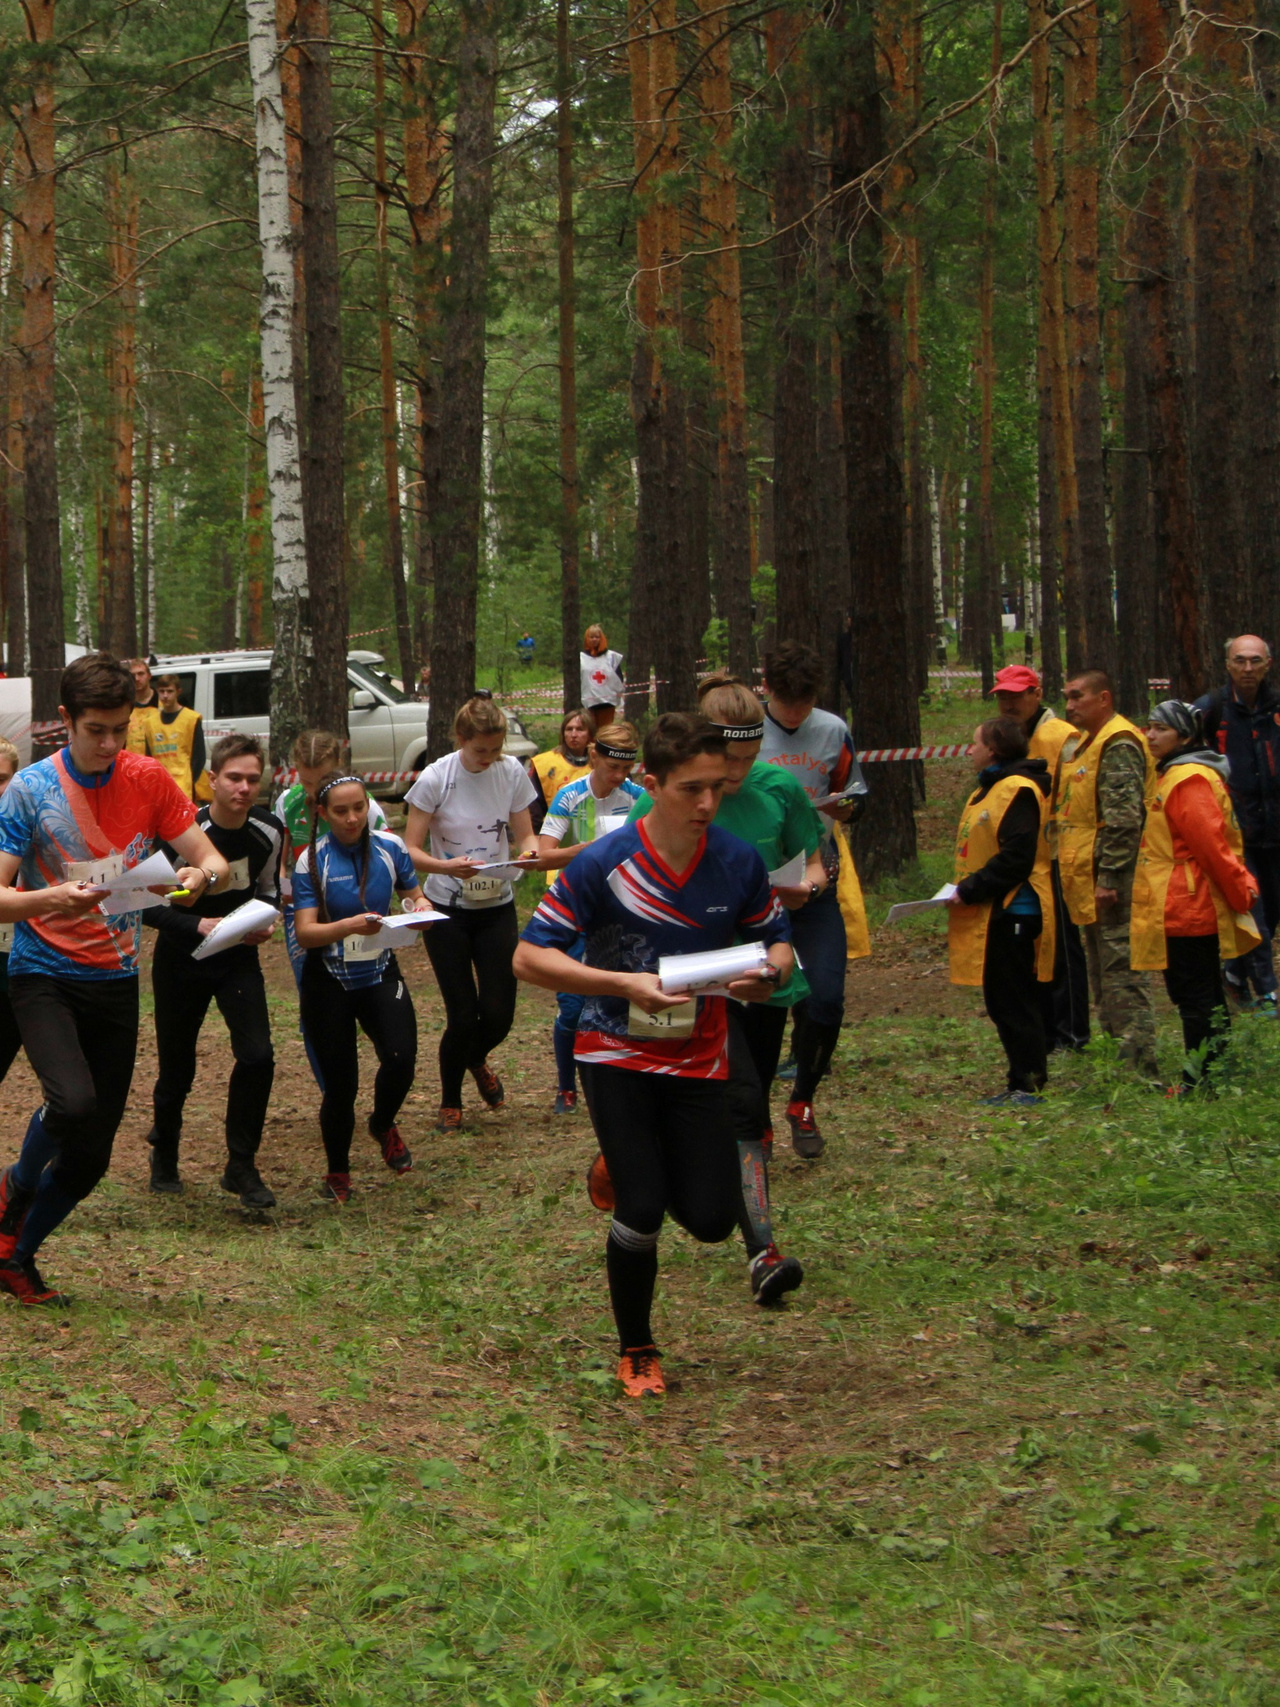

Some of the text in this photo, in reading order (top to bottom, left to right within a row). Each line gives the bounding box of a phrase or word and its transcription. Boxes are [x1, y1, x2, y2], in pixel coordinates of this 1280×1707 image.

[723, 728, 763, 739] nonam
[767, 752, 829, 775] ntalya
[469, 880, 496, 891] 102.1
